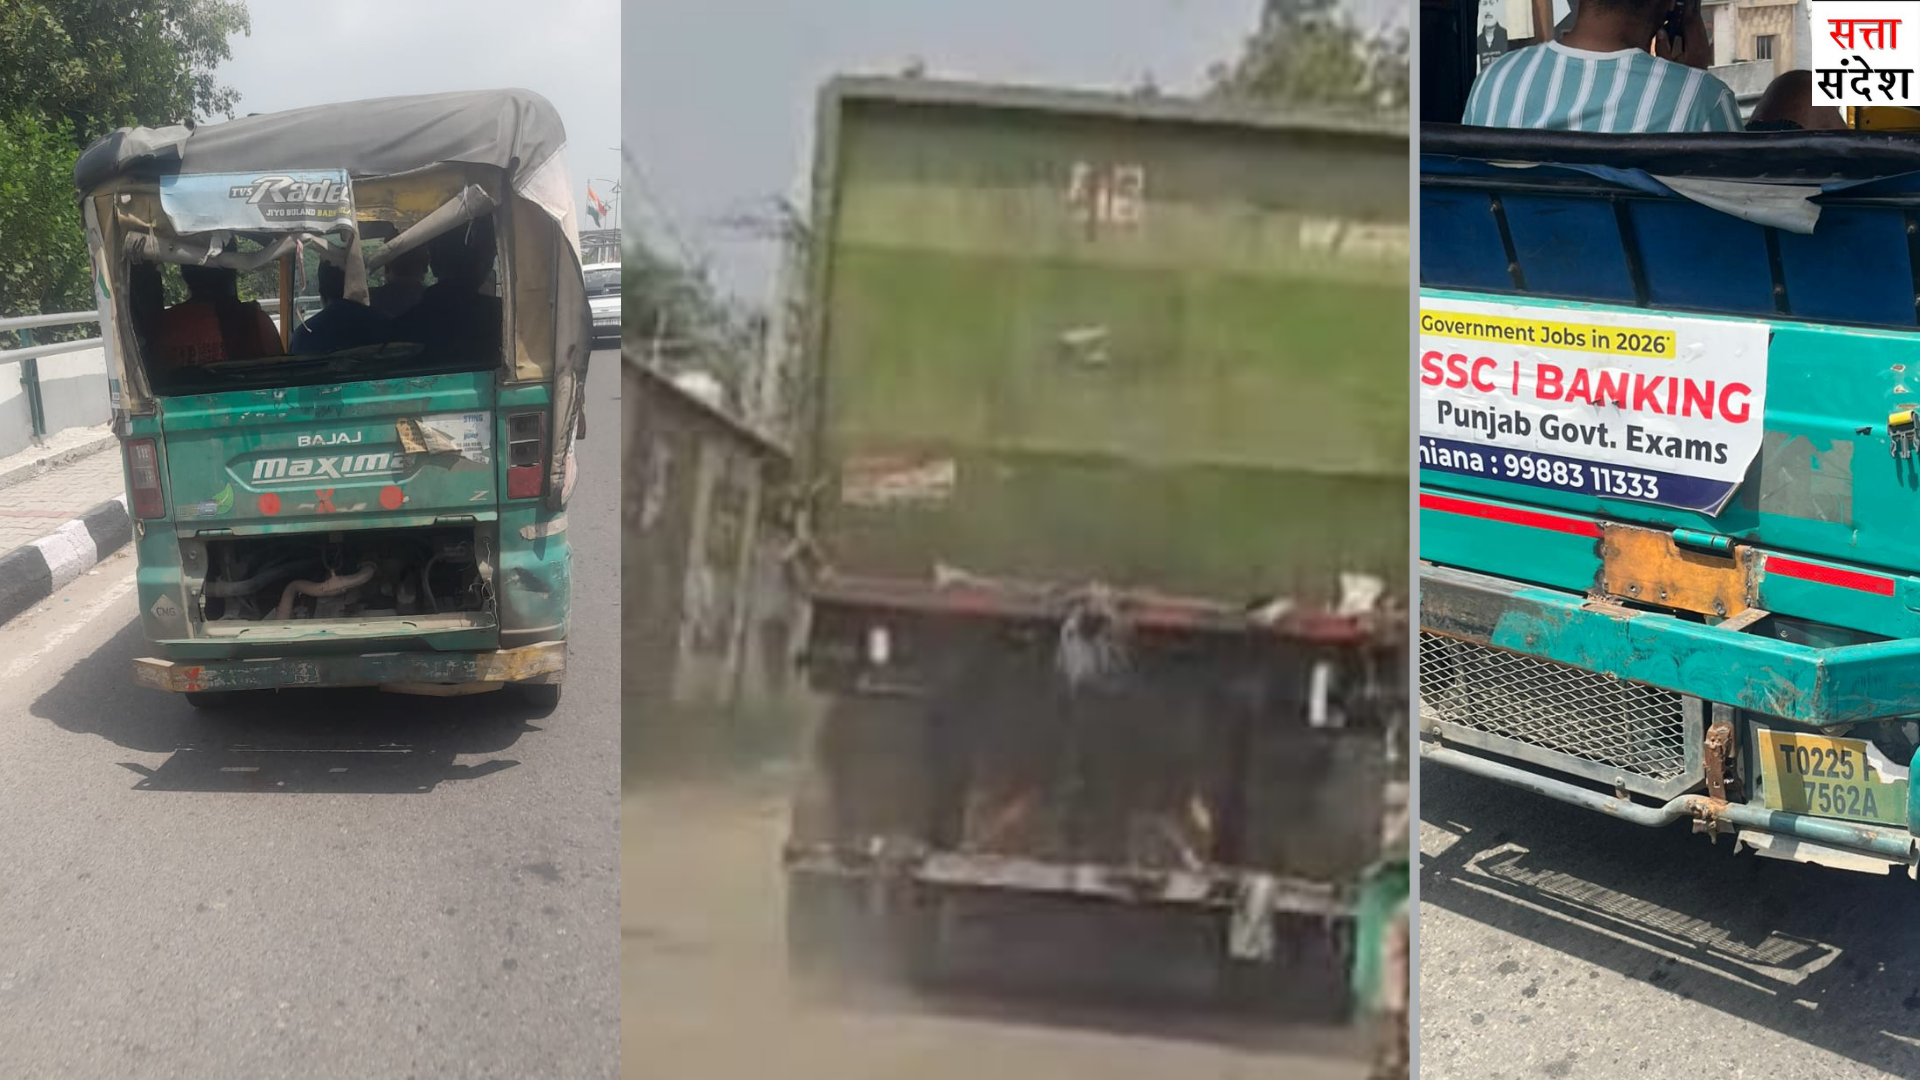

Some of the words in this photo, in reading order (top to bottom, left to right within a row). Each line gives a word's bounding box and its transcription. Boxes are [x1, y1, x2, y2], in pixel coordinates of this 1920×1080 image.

[231, 187, 254, 198] TVS
[265, 208, 285, 217] JIYO
[1421, 314, 1536, 342] Government
[1540, 326, 1586, 347] Jobs
[1592, 329, 1610, 349] in
[1421, 350, 1498, 393] SSC
[1535, 363, 1753, 424] BANKING
[297, 431, 362, 447] BAJAJ
[1437, 399, 1532, 440] Punjab
[1539, 414, 1617, 449] Govt.
[1626, 424, 1729, 465] Exams
[1503, 453, 1585, 488] 99883
[1589, 466, 1660, 499] 11333
[156, 606, 176, 617] CNG
[1780, 744, 1854, 780] T0225
[1804, 781, 1879, 818] 7562A
